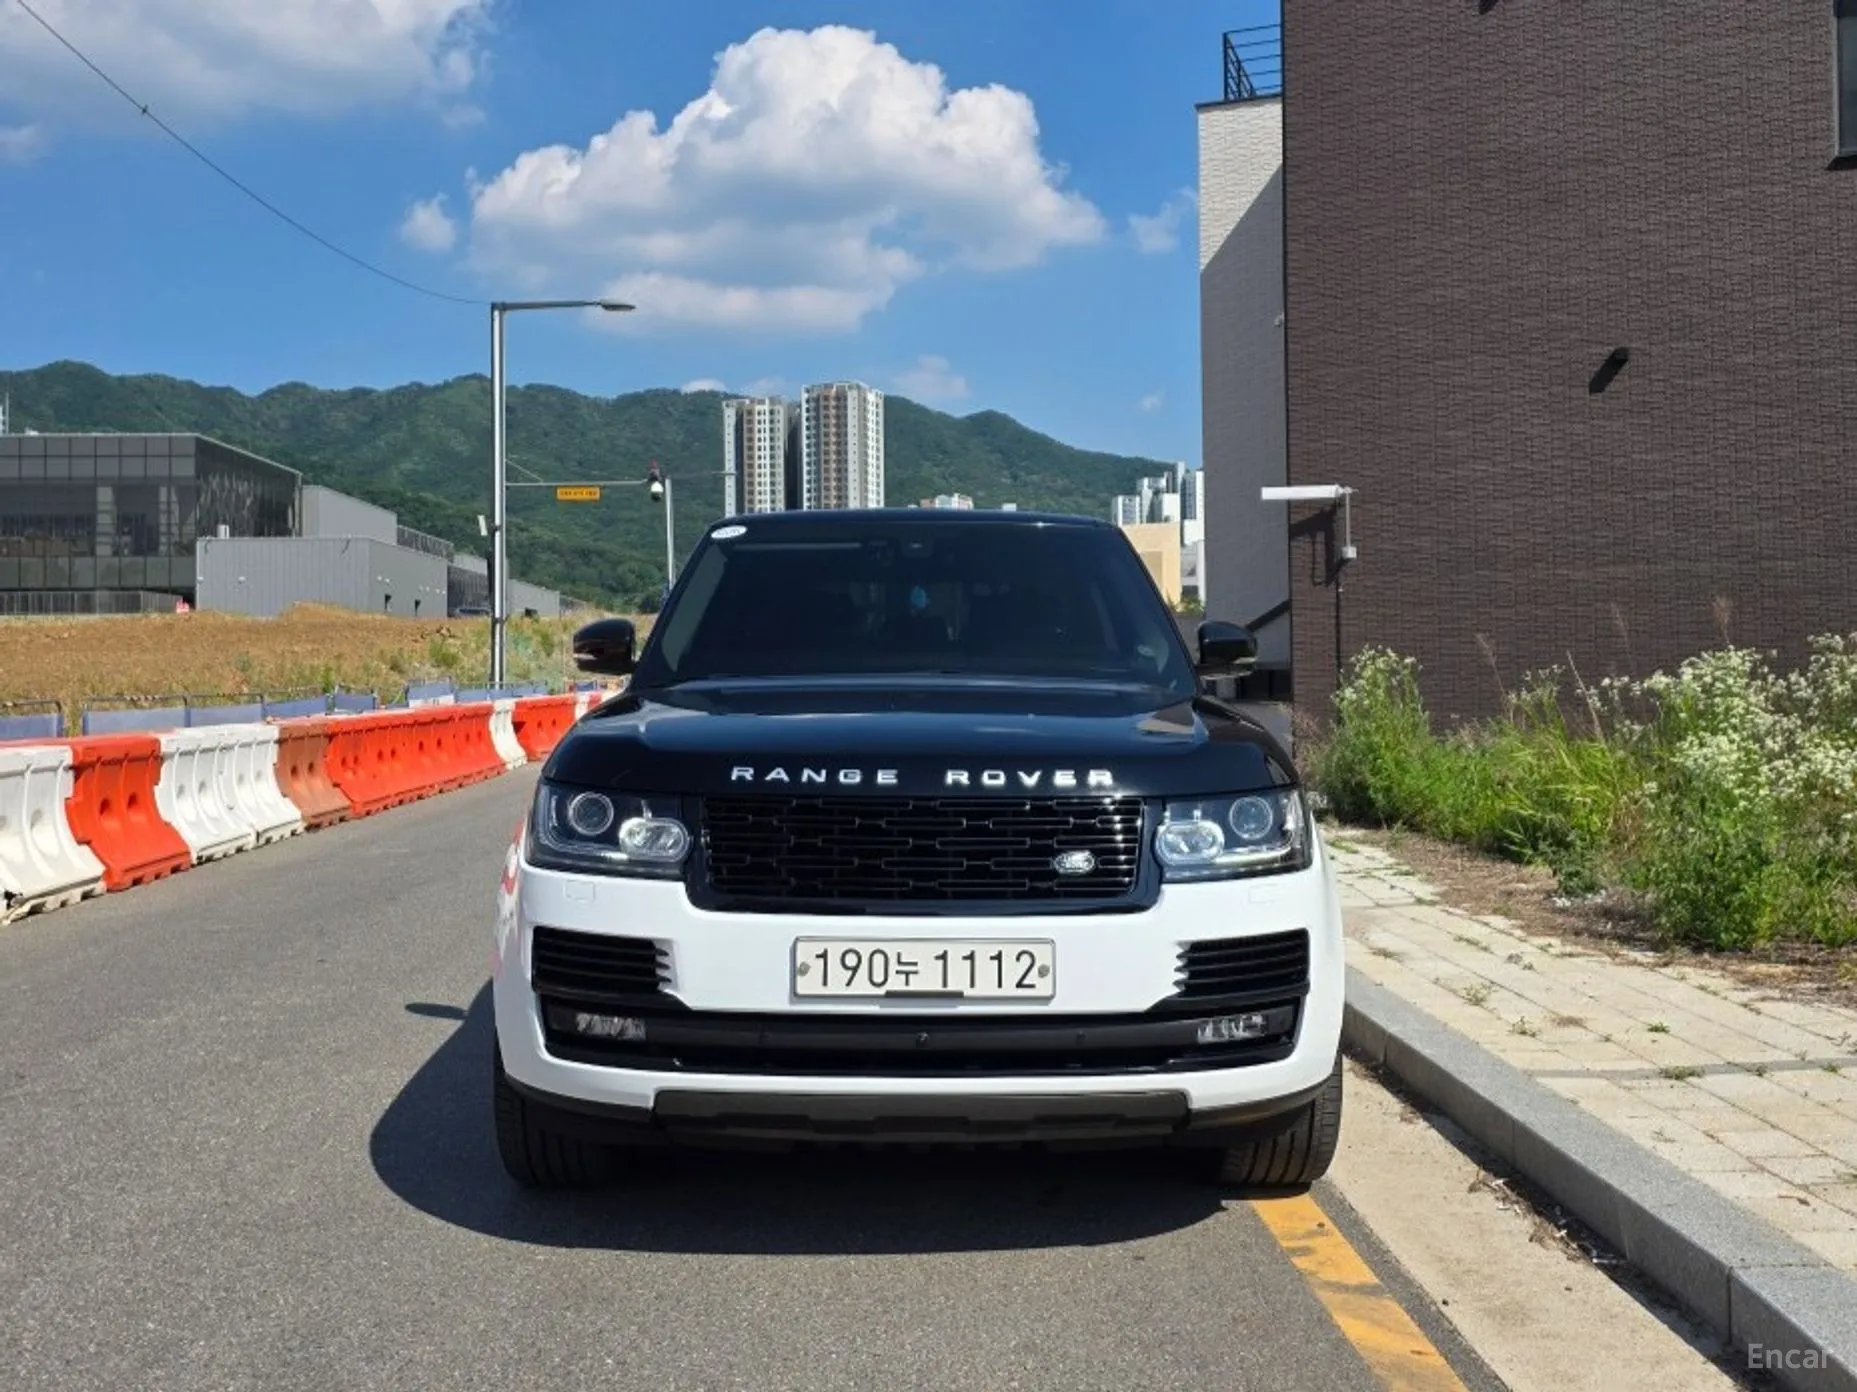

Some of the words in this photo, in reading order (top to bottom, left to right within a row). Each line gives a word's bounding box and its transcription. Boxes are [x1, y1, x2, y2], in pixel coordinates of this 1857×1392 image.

[730, 766, 899, 785] RANGE
[945, 769, 1114, 787] ROVER
[934, 949, 1037, 989] 1112
